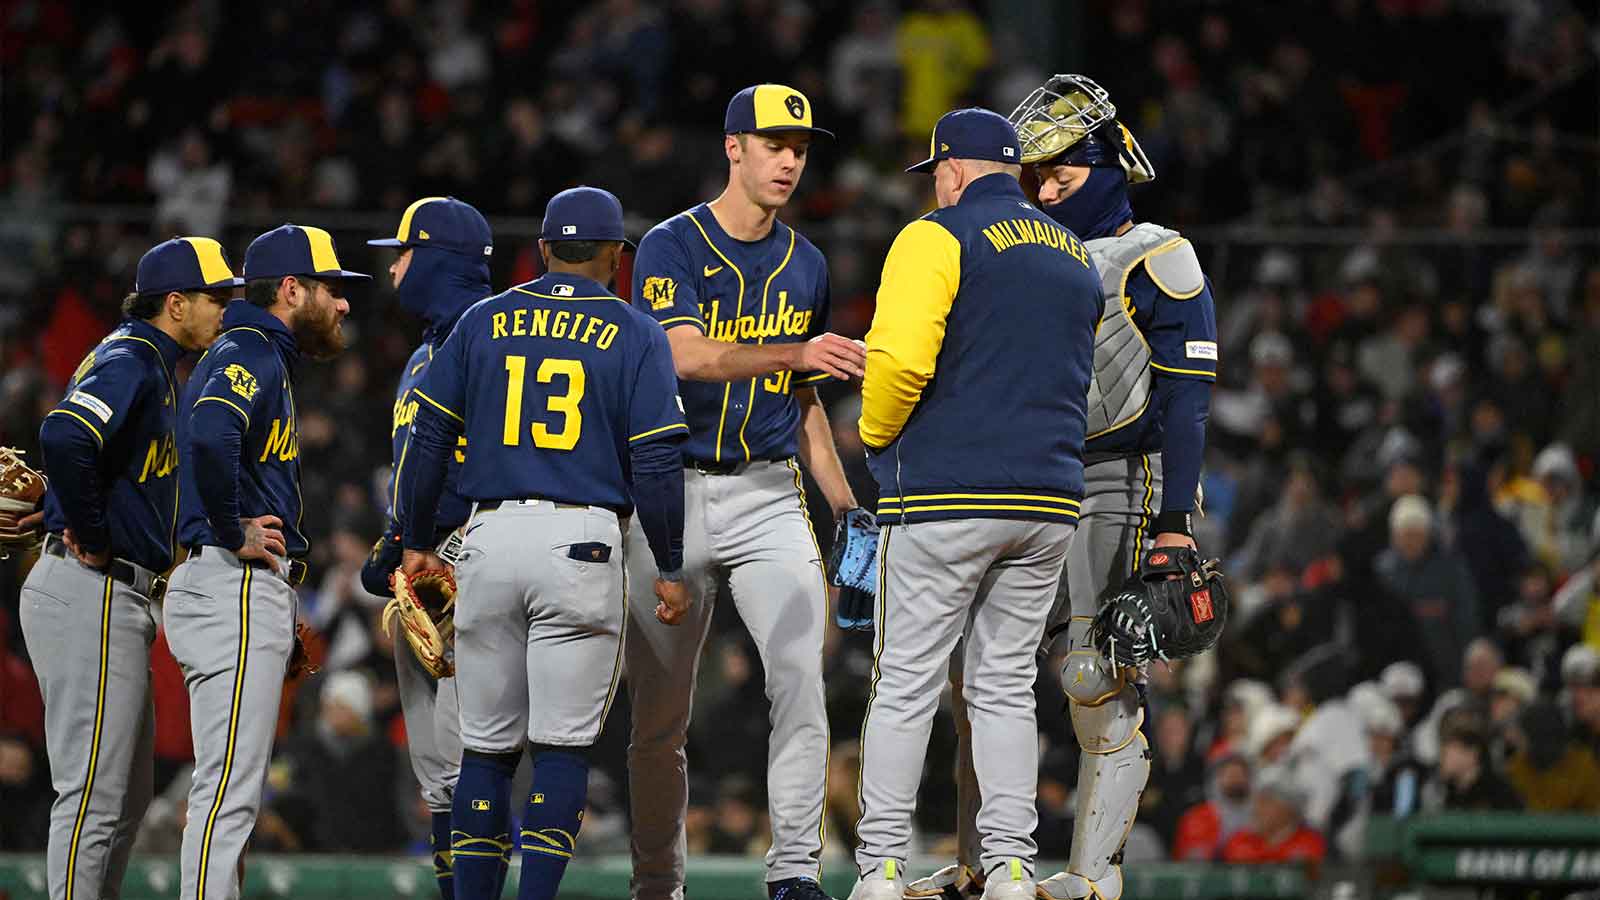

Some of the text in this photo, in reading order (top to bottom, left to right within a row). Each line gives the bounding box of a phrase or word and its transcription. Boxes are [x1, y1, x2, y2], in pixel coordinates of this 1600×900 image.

[982, 219, 1090, 269] MILWAUKEE
[492, 309, 619, 350] RENGIFO
[503, 355, 586, 451] 13
